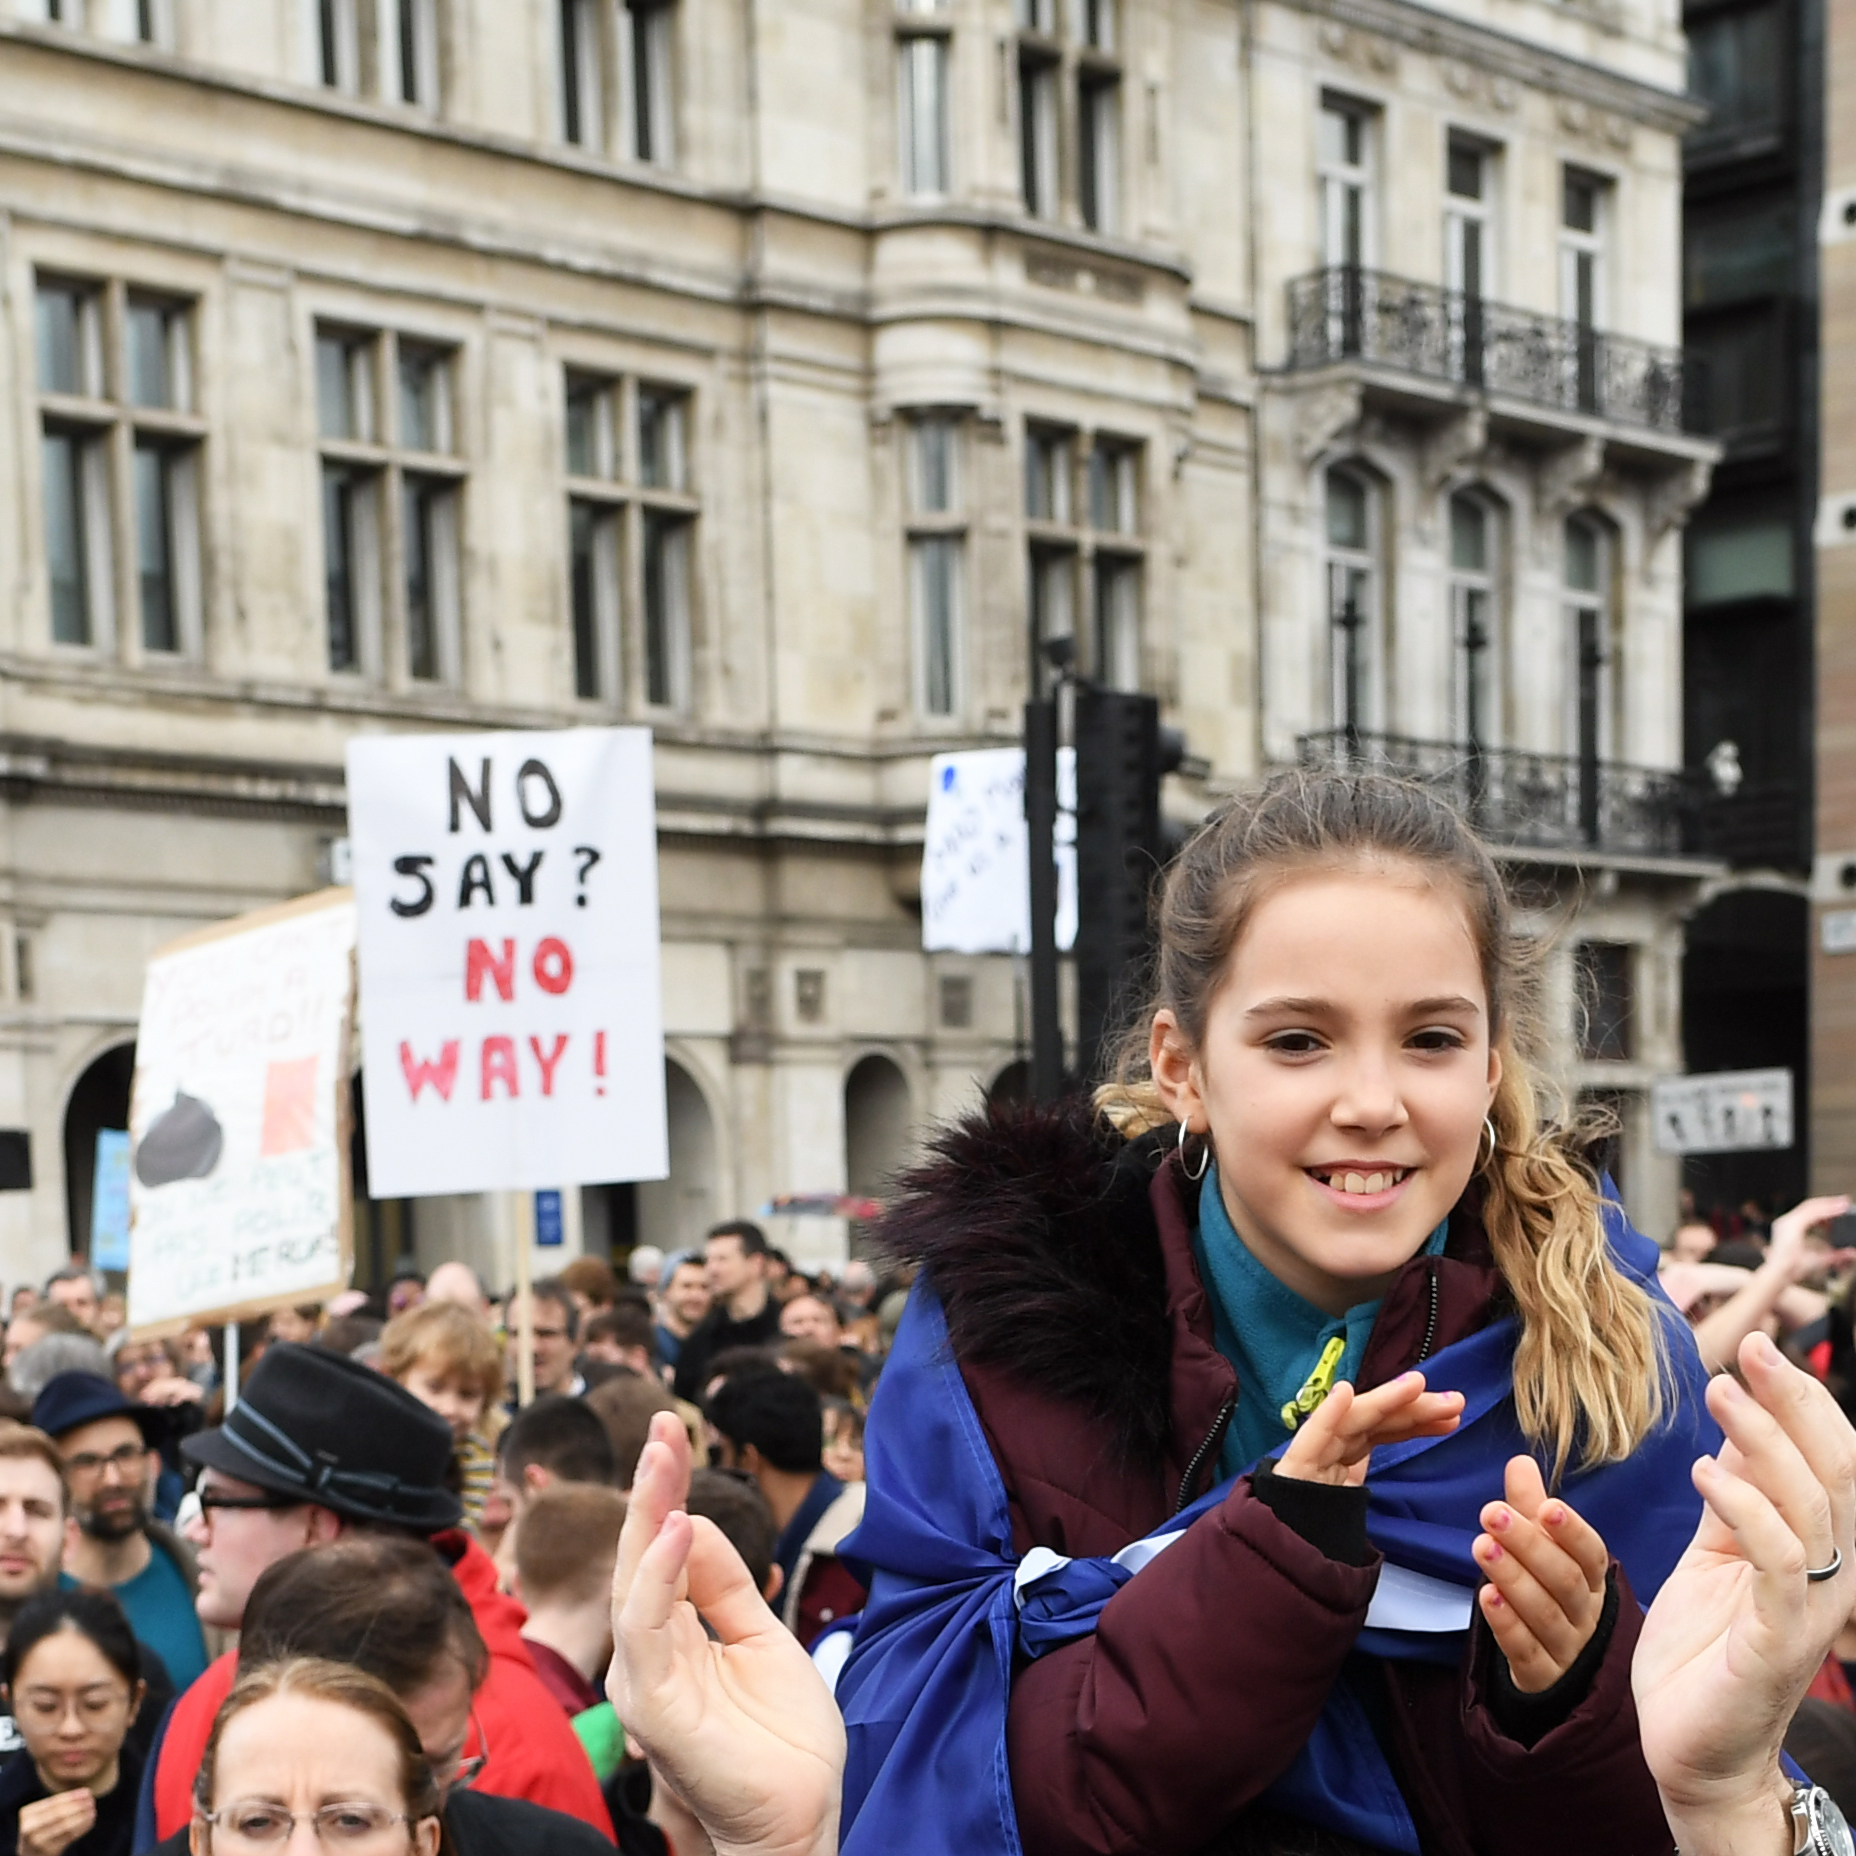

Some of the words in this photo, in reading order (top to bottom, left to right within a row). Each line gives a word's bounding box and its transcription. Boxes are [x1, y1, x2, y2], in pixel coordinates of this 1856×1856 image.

[448, 756, 562, 833] NO
[390, 846, 600, 918] SAY?
[465, 937, 574, 1002] NO
[400, 1031, 607, 1101] WAY!
